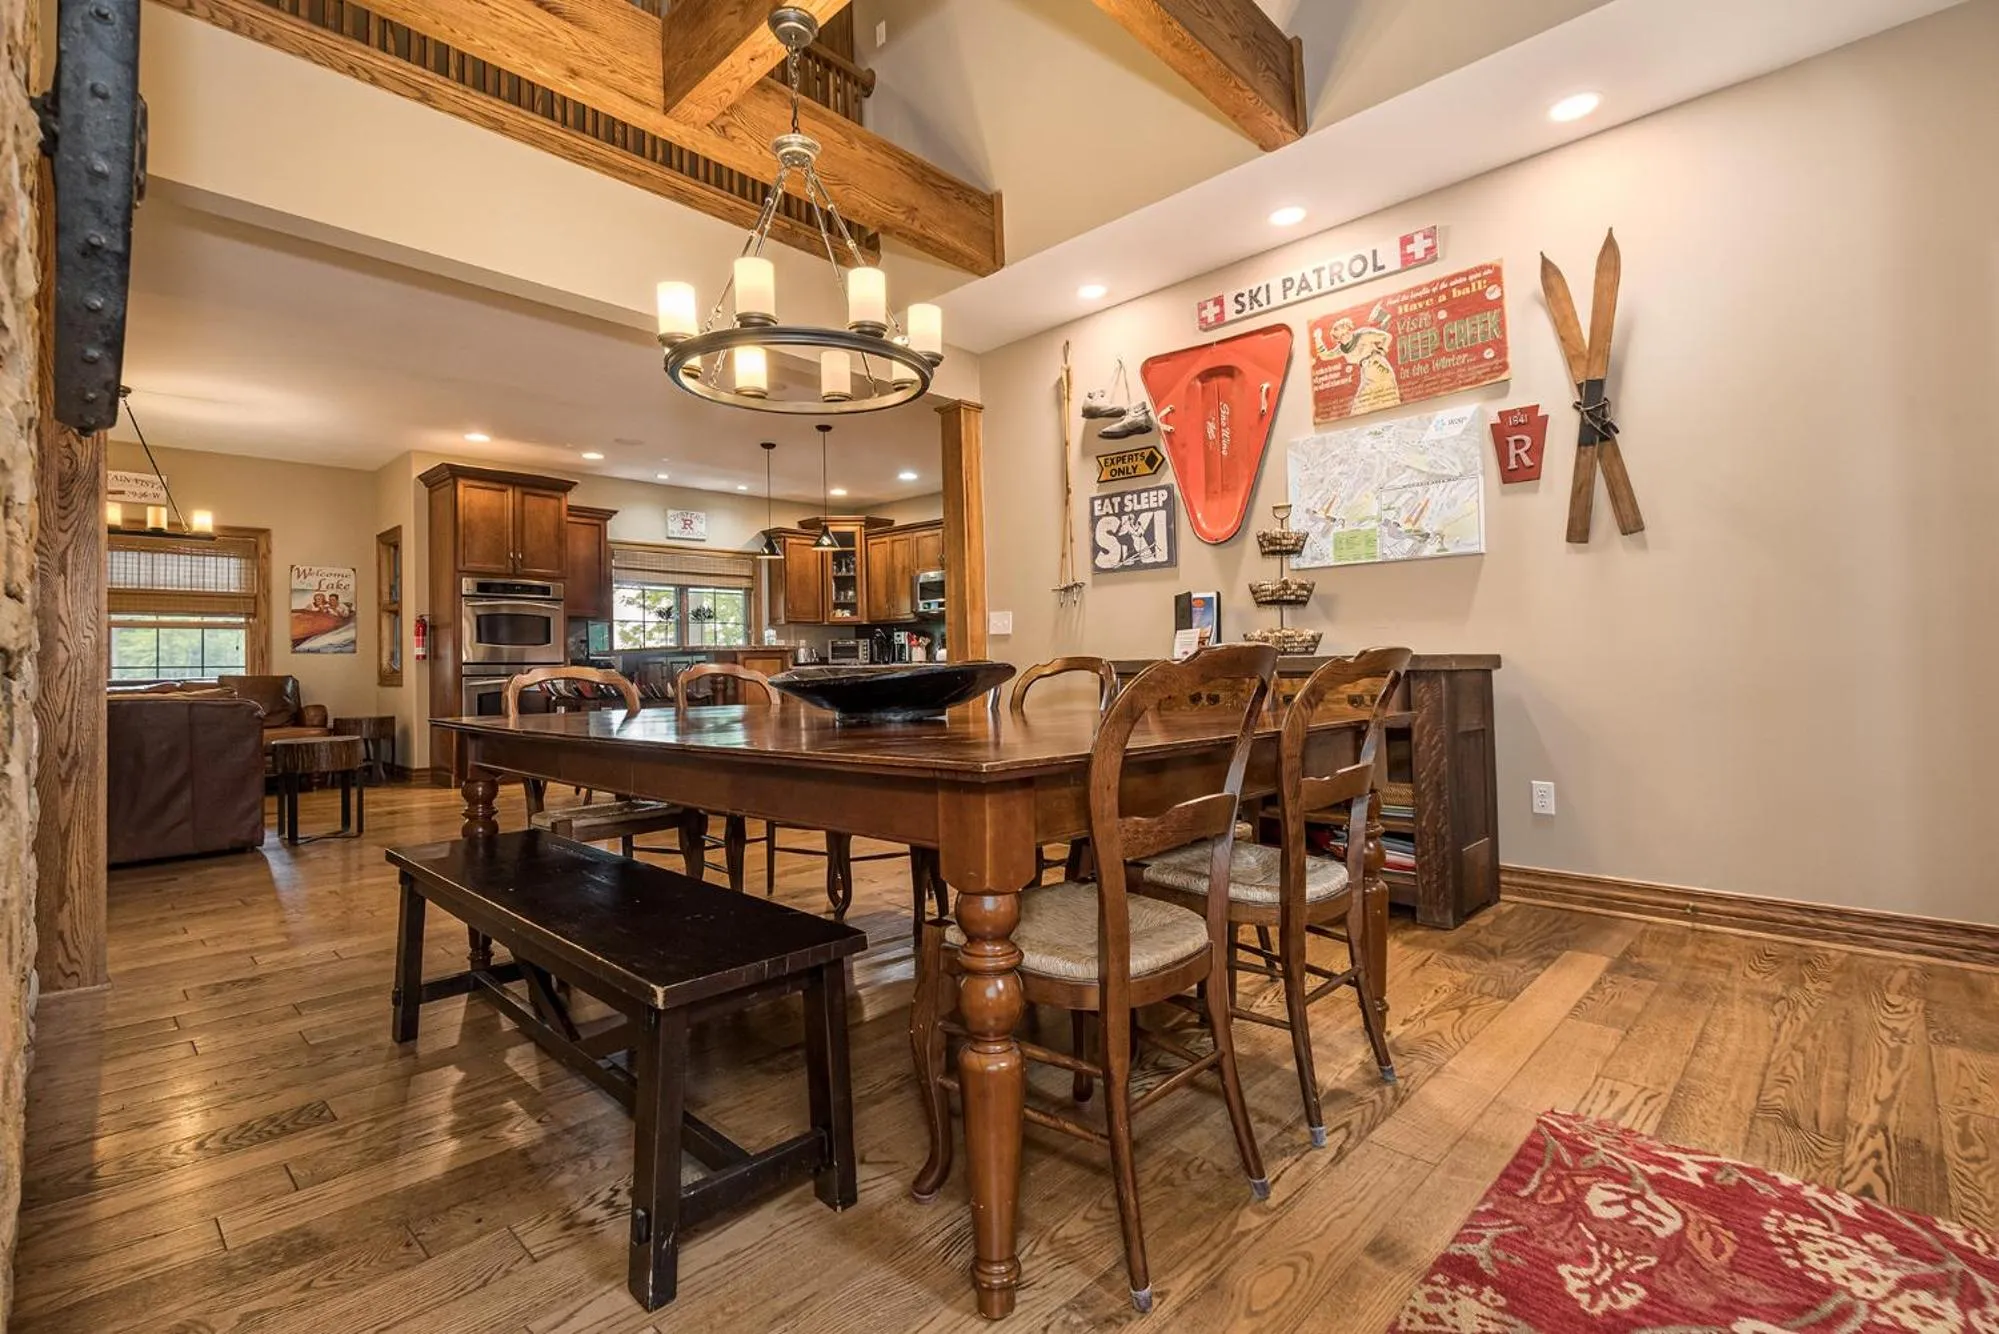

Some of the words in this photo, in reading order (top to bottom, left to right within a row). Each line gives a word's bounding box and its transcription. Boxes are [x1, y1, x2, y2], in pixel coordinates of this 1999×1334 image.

[1234, 283, 1272, 315] SKI
[1282, 248, 1386, 301] PATROL
[1398, 297, 1434, 315] Have
[1438, 294, 1447, 303] a
[1397, 327, 1440, 365] DEEP
[1443, 308, 1502, 352] CREEK
[1104, 451, 1146, 467] EXPERTS
[1505, 434, 1535, 470] R
[1109, 464, 1138, 478] ONLY
[1093, 497, 1121, 516] EAT
[1123, 489, 1168, 513] SLEEP
[680, 518, 694, 530] R
[1094, 509, 1169, 569] SKI
[295, 566, 352, 580] Welcome
[314, 578, 350, 592] Lake
